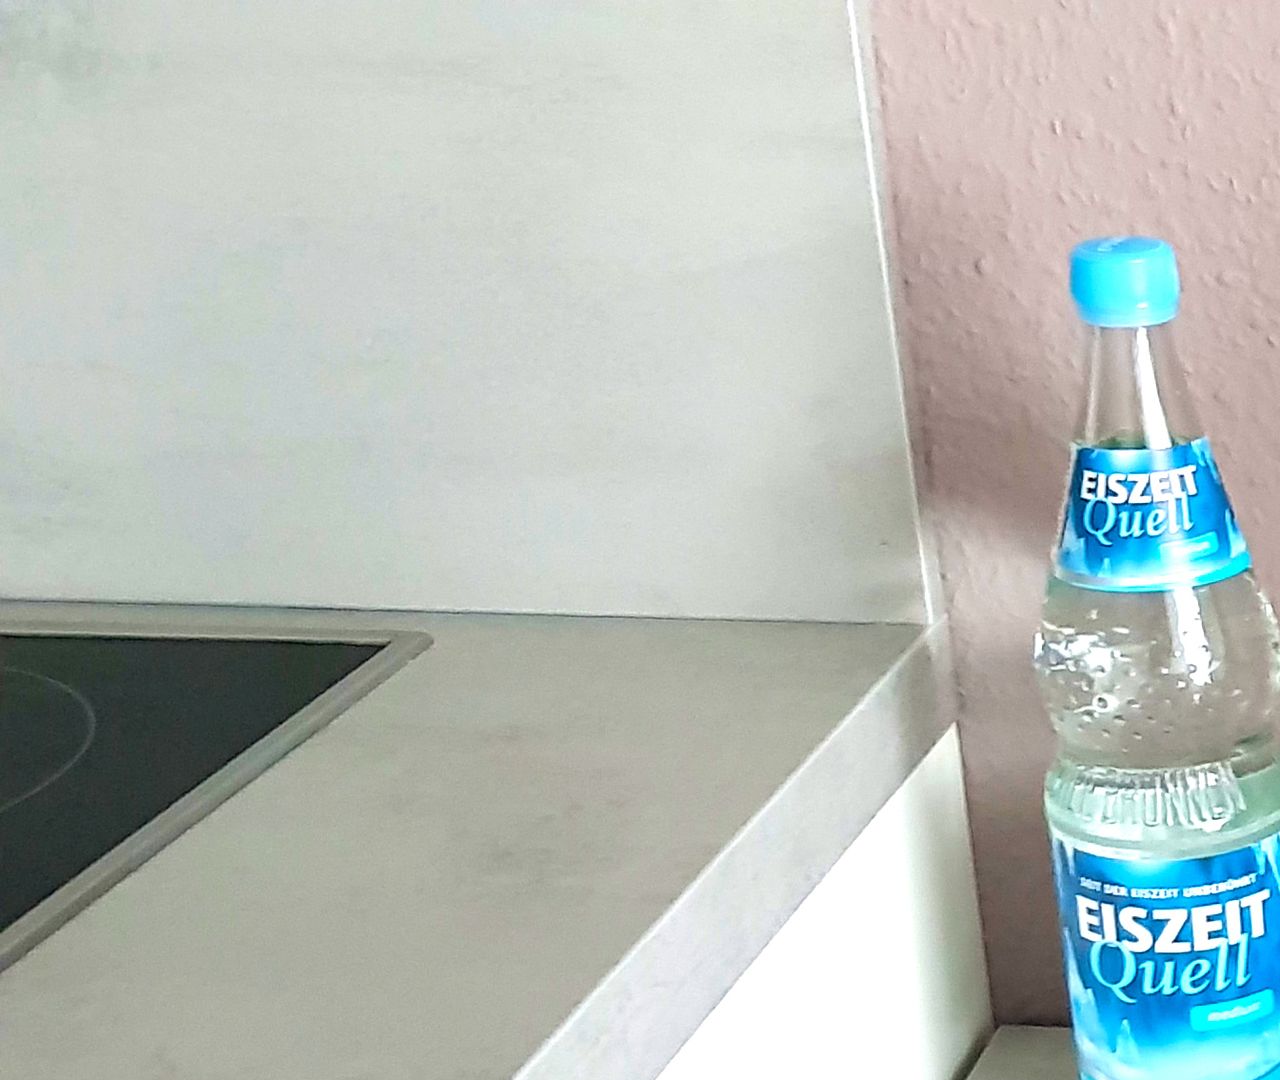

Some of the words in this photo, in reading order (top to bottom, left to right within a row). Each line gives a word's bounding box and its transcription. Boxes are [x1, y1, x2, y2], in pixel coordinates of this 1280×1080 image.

[1080, 465, 1198, 505] EISZEIT
[1083, 493, 1194, 546] Quell
[1075, 889, 1271, 954] EISZEIT
[1091, 934, 1251, 1003] Quell
